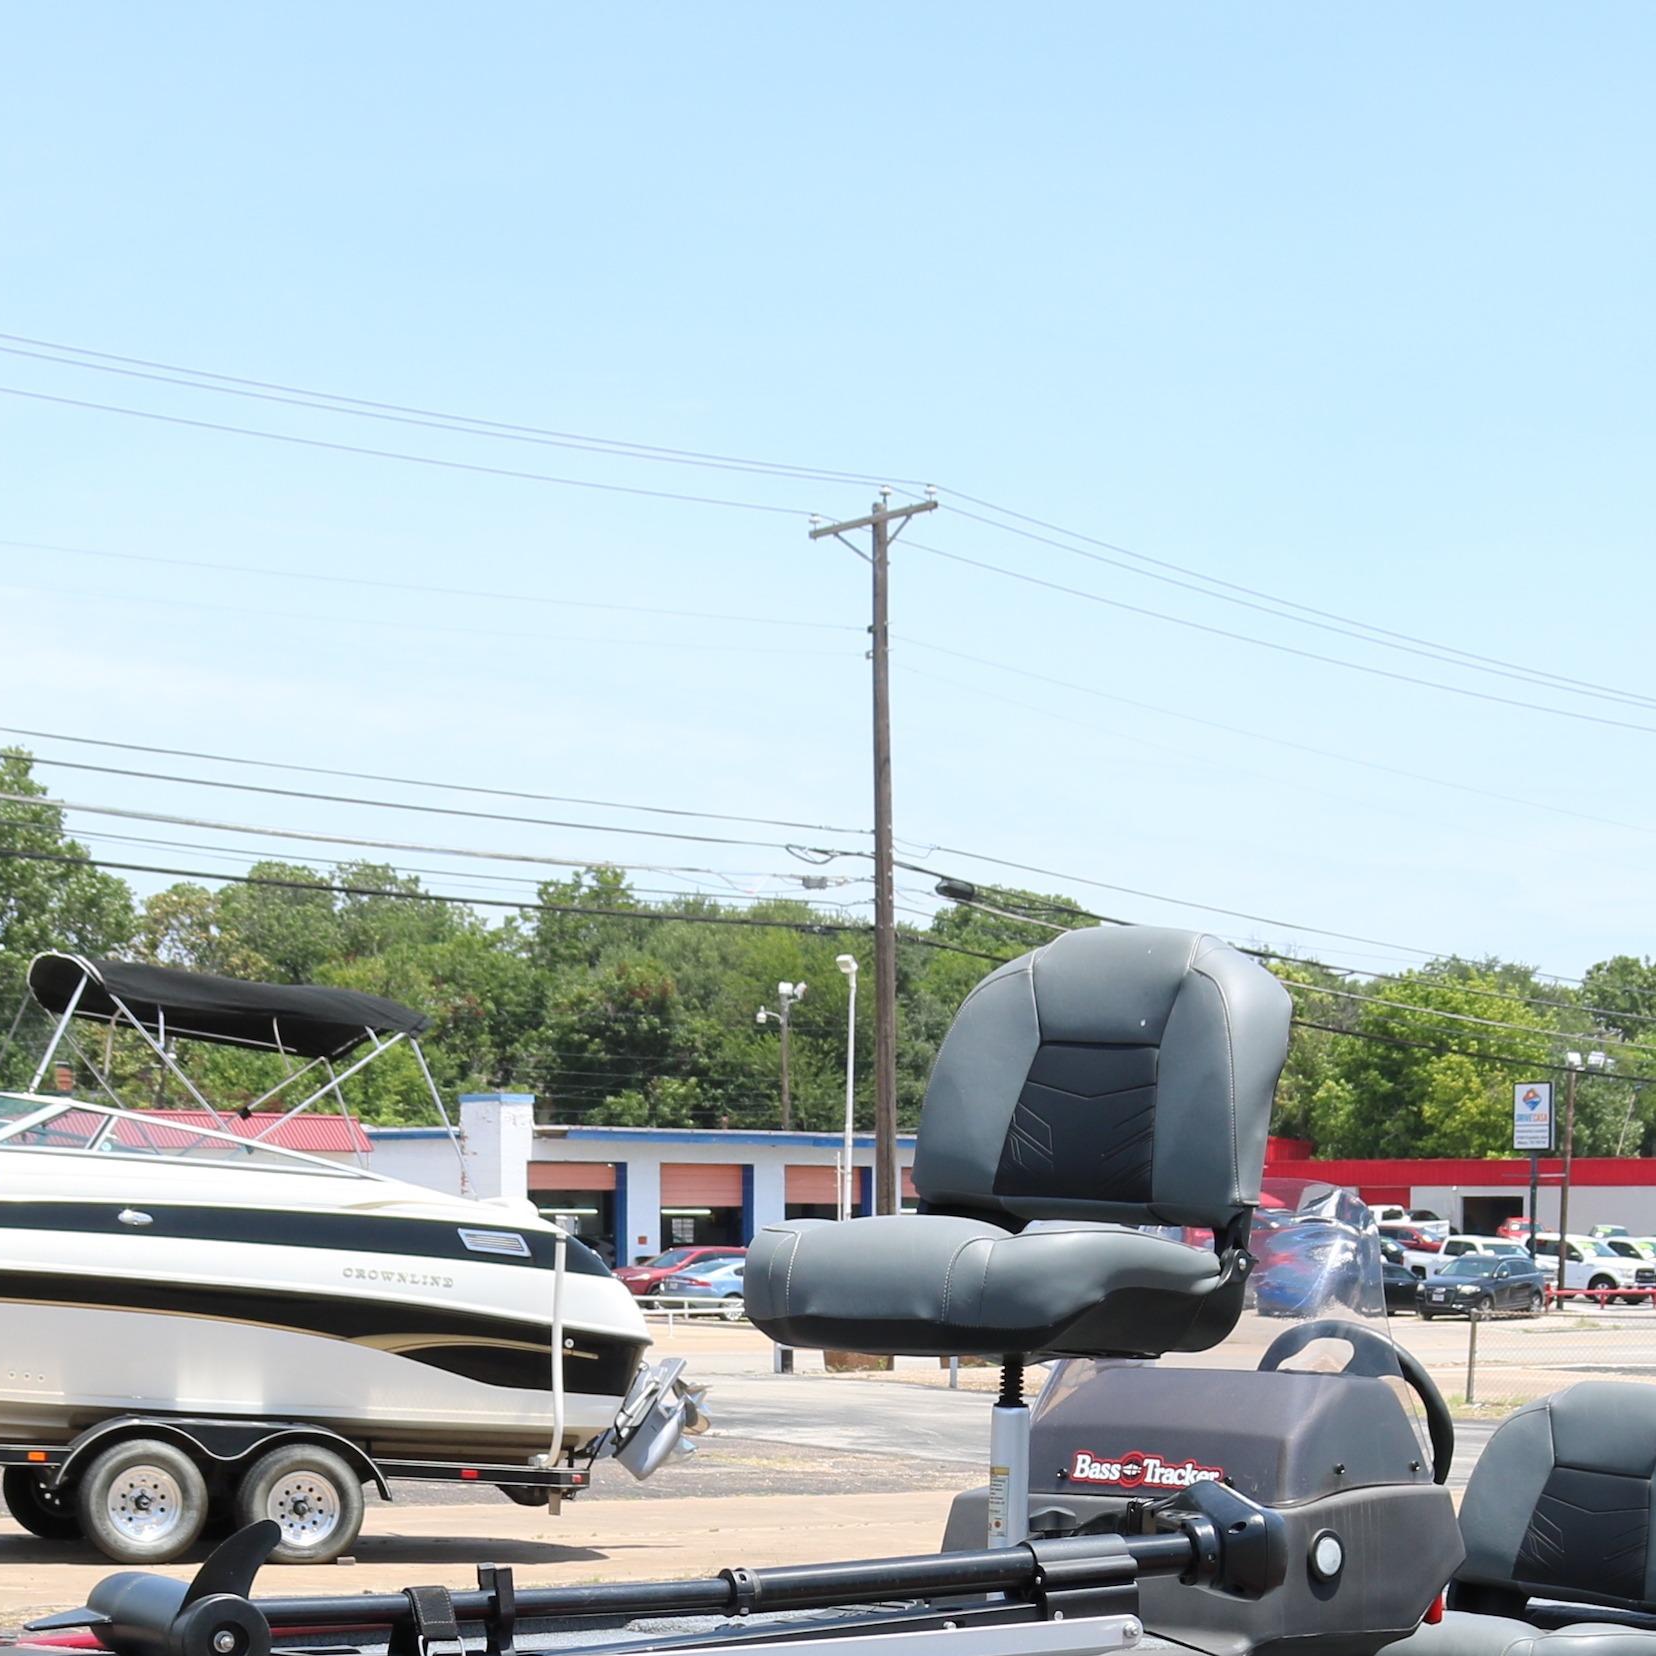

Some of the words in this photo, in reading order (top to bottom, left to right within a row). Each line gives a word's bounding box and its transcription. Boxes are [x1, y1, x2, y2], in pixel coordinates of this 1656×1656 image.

[342, 1267, 454, 1289] CROWNLINE
[1073, 1454, 1122, 1481] Bass
[1143, 1458, 1220, 1486] Tracker
